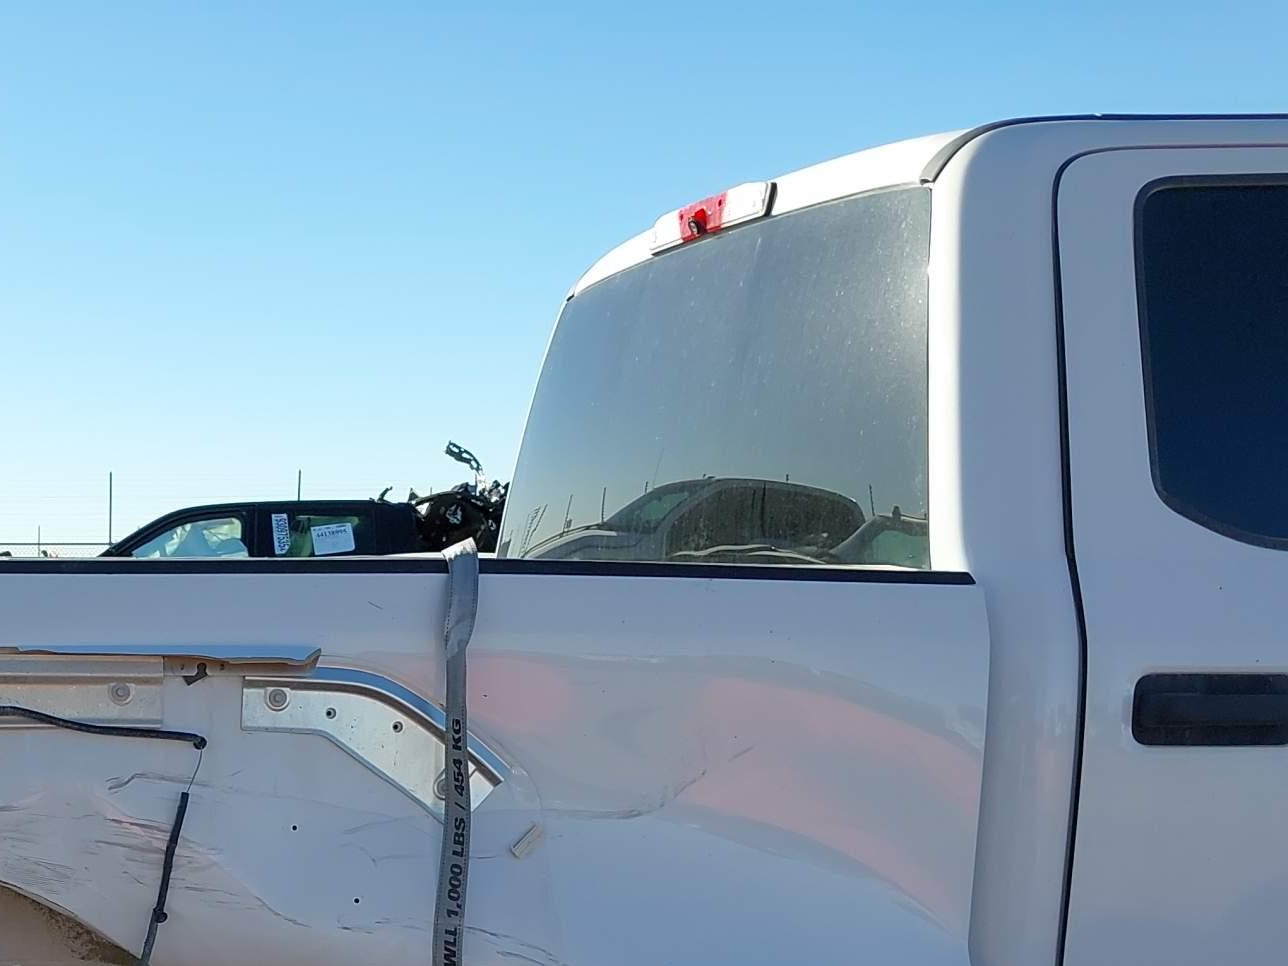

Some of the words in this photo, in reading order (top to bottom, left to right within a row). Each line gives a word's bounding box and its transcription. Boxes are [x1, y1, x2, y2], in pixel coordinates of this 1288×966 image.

[451, 718, 462, 752] KG
[452, 758, 465, 797] 454
[452, 817, 466, 858] LBS
[447, 863, 462, 919] 1,000
